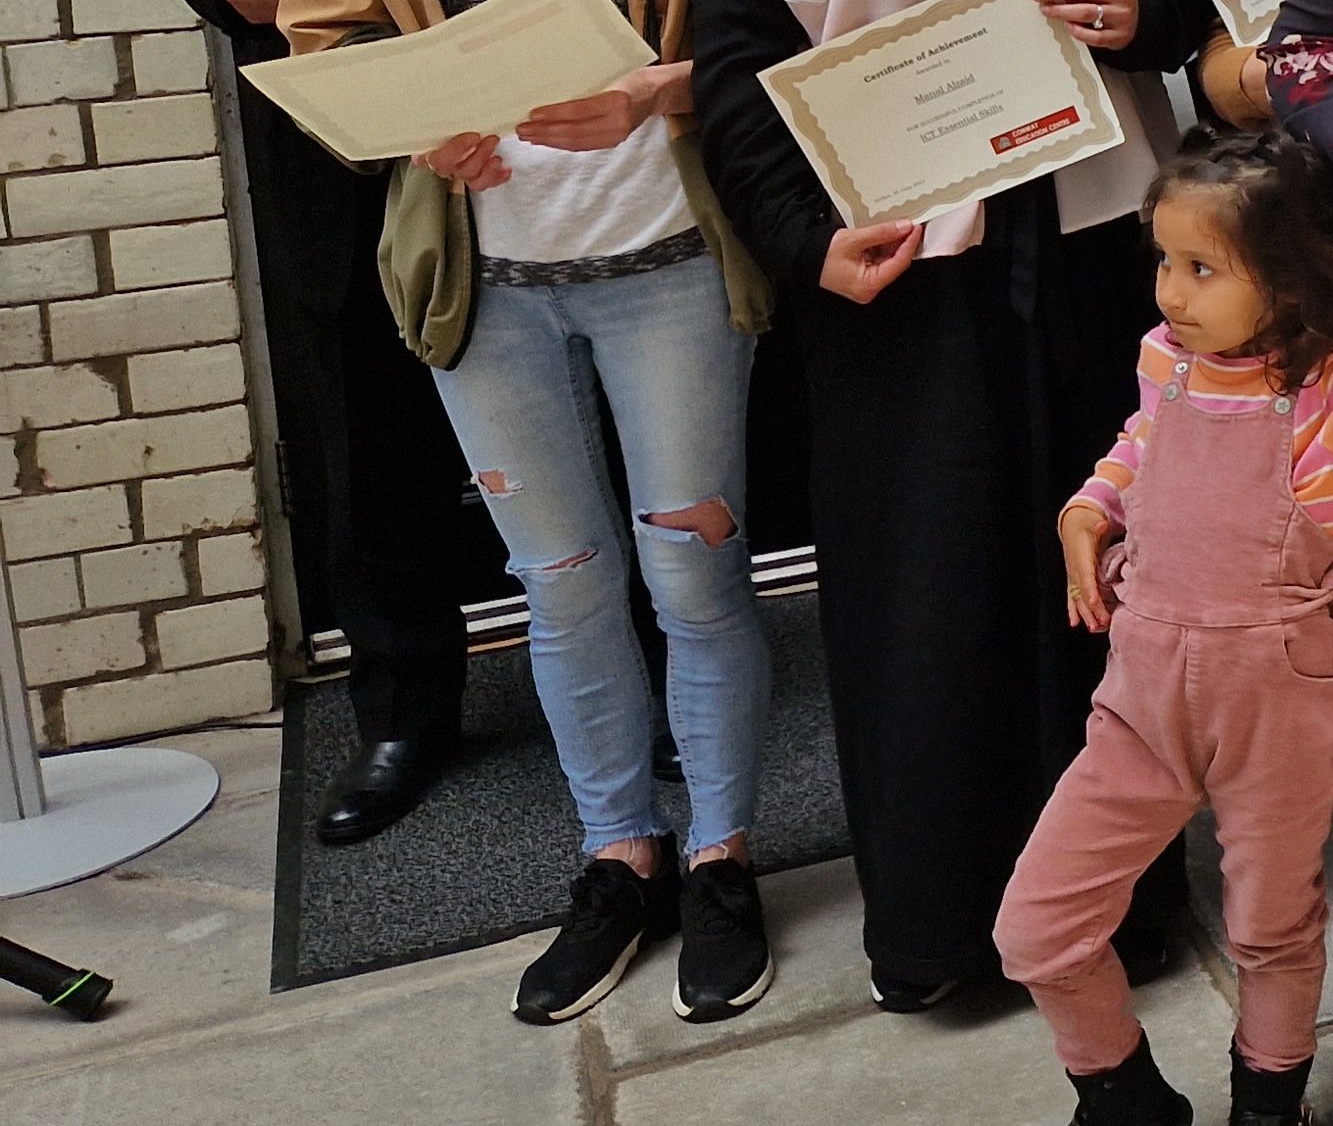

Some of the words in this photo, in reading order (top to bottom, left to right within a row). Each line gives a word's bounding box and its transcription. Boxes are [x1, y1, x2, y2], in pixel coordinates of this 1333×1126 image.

[864, 59, 914, 83] Certificate
[916, 52, 926, 62] of
[928, 27, 988, 57] Achievement
[920, 131, 939, 143] ICT
[938, 113, 978, 135] Essential
[979, 104, 1004, 120] Skills
[1012, 122, 1039, 137] CONWAY
[1015, 127, 1049, 144] EDUCATION
[1048, 118, 1070, 132] CENTRE
